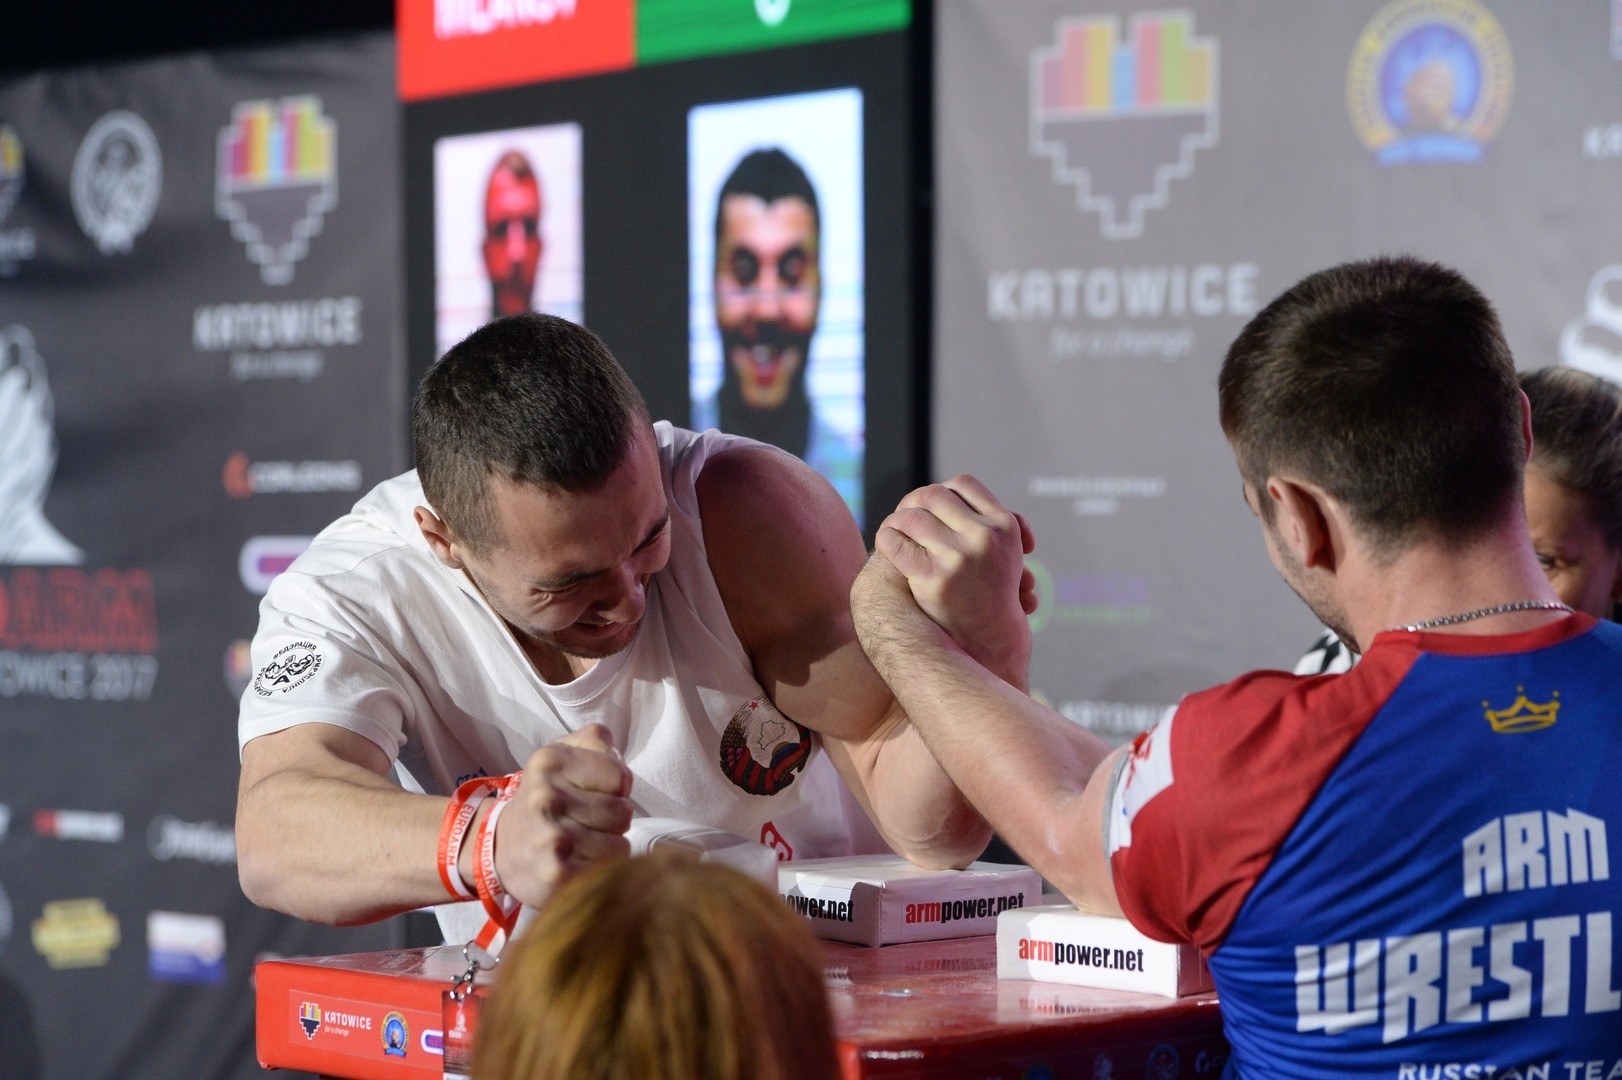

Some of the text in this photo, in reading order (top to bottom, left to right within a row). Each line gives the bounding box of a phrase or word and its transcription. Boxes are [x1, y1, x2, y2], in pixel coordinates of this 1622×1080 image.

[988, 263, 1259, 320] KATOWICE
[193, 297, 363, 351] KATOWICE
[88, 653, 159, 700] 2017
[446, 804, 475, 867] EUROARM
[1462, 807, 1610, 899] ARM
[481, 831, 502, 896] EUROARM
[778, 893, 854, 923] ower.net
[905, 892, 1025, 924] armpower.net
[1018, 935, 1145, 973] armpower.net
[1294, 910, 1622, 1045] WRESTL
[324, 1010, 372, 1031] KATOWICE
